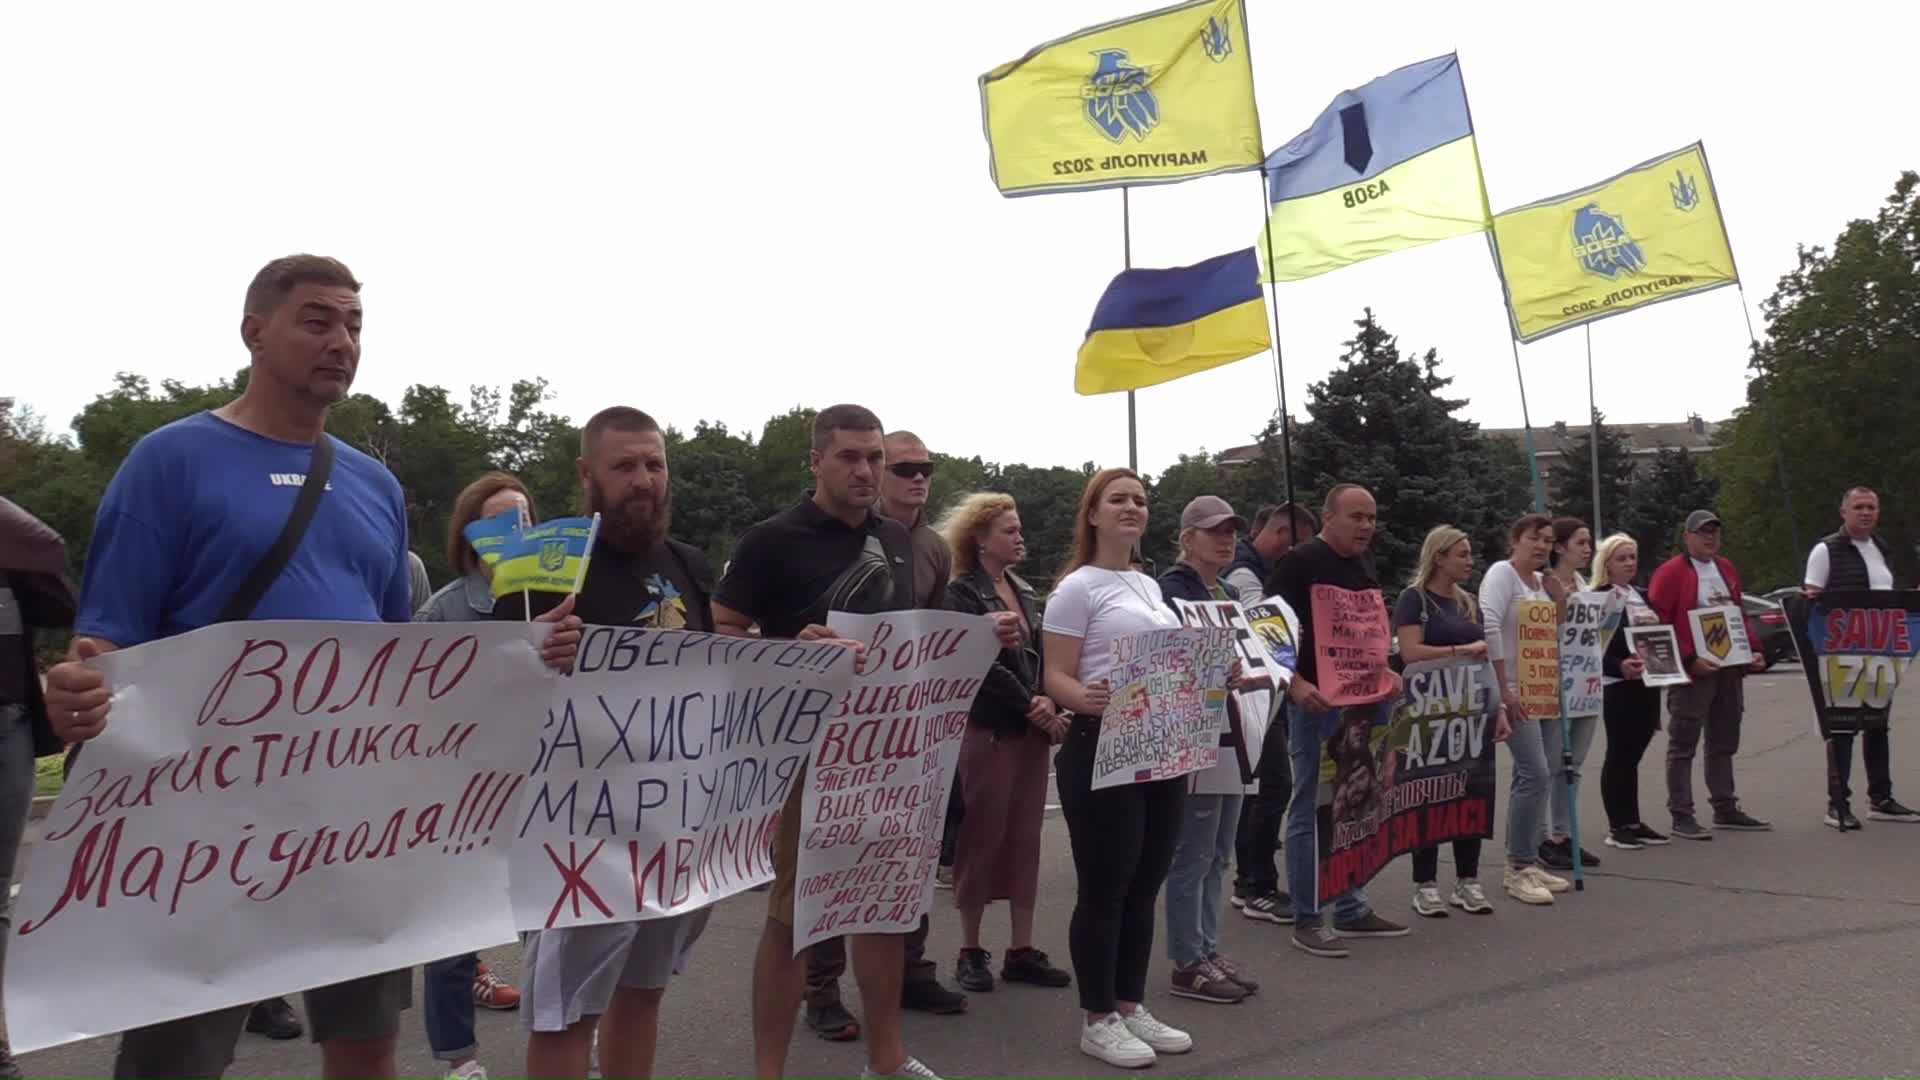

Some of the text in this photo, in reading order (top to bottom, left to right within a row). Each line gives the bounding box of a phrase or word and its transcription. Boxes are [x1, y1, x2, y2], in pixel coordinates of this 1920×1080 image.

[560, 627, 847, 677] ОВЕРНІТЬ!!!
[1824, 607, 1912, 653] SAVE
[197, 635, 479, 727] ВОЛЮ
[1408, 664, 1485, 718] SAVE
[1405, 713, 1489, 770] AZOV
[519, 755, 799, 839] МАРІУПОЛЯ
